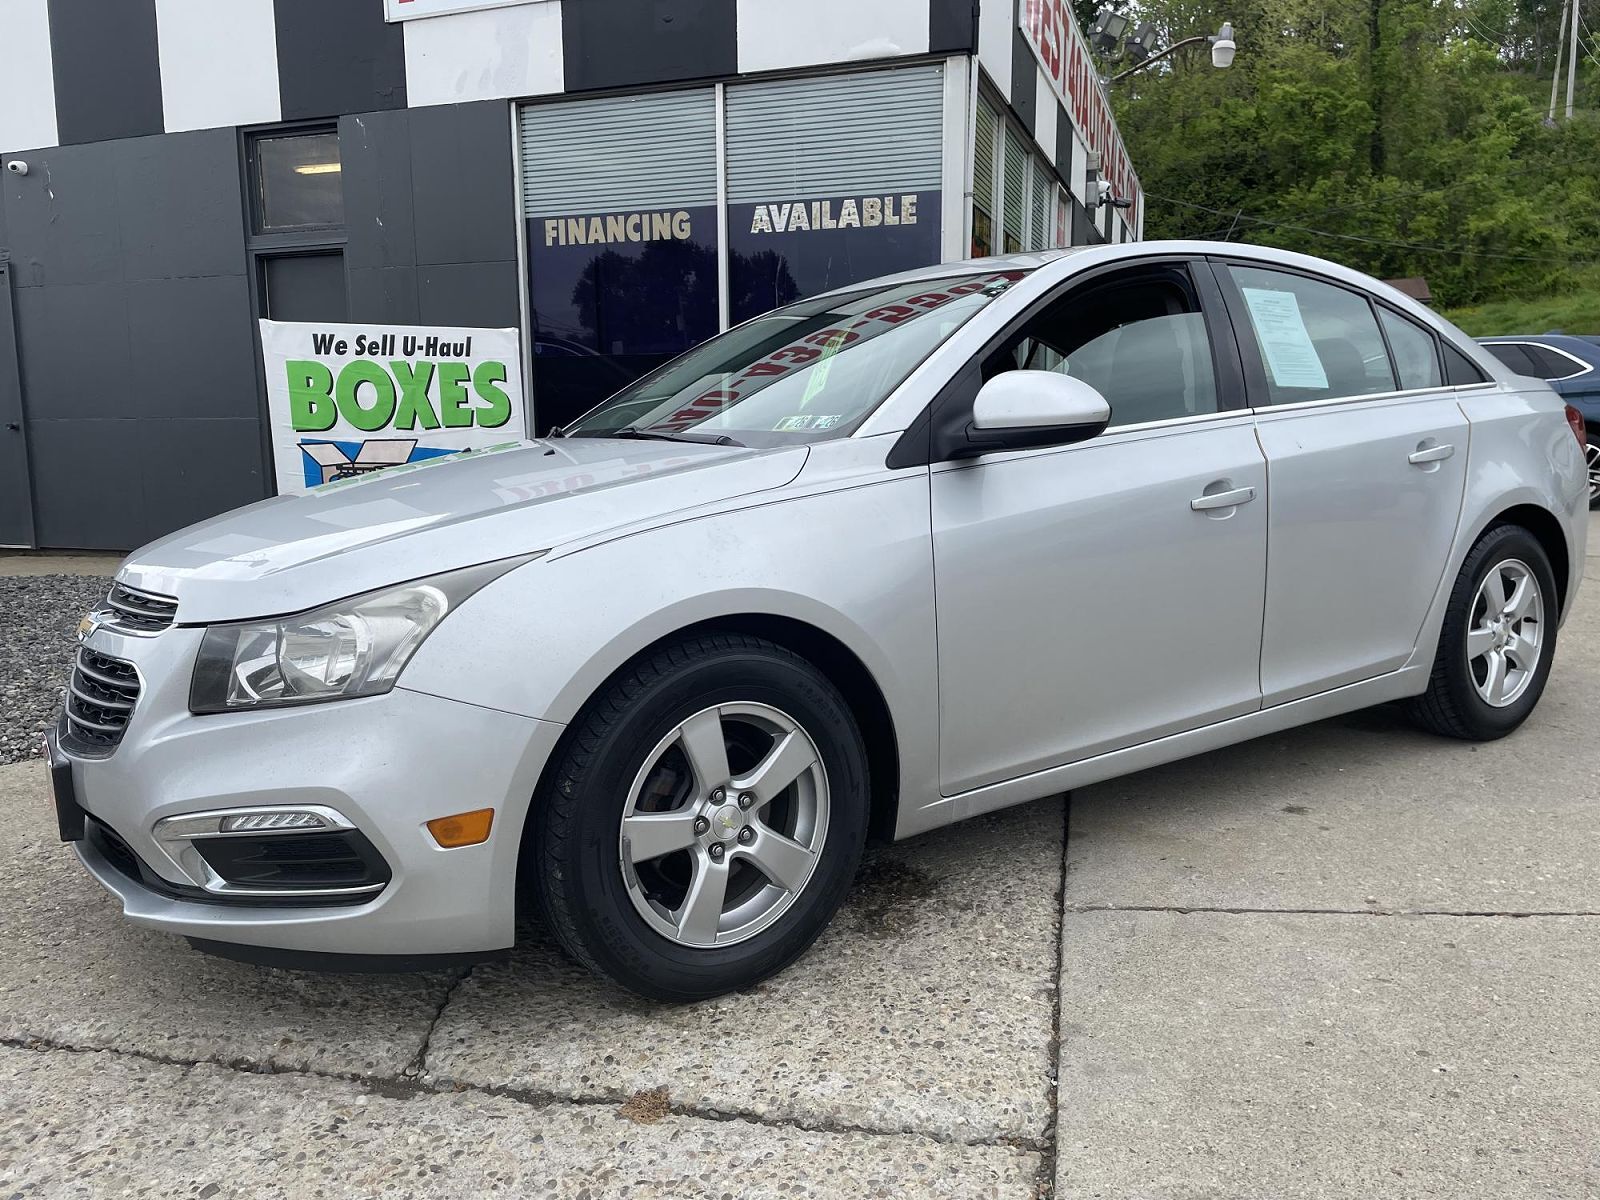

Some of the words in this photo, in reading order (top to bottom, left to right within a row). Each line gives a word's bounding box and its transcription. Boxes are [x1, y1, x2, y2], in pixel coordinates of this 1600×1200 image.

[544, 210, 691, 247] FINANCING
[750, 194, 918, 234] AVAILABLE
[312, 333, 348, 355] We
[354, 333, 395, 356] Sell
[402, 335, 472, 357] U-Haul
[285, 359, 512, 432] BOXES
